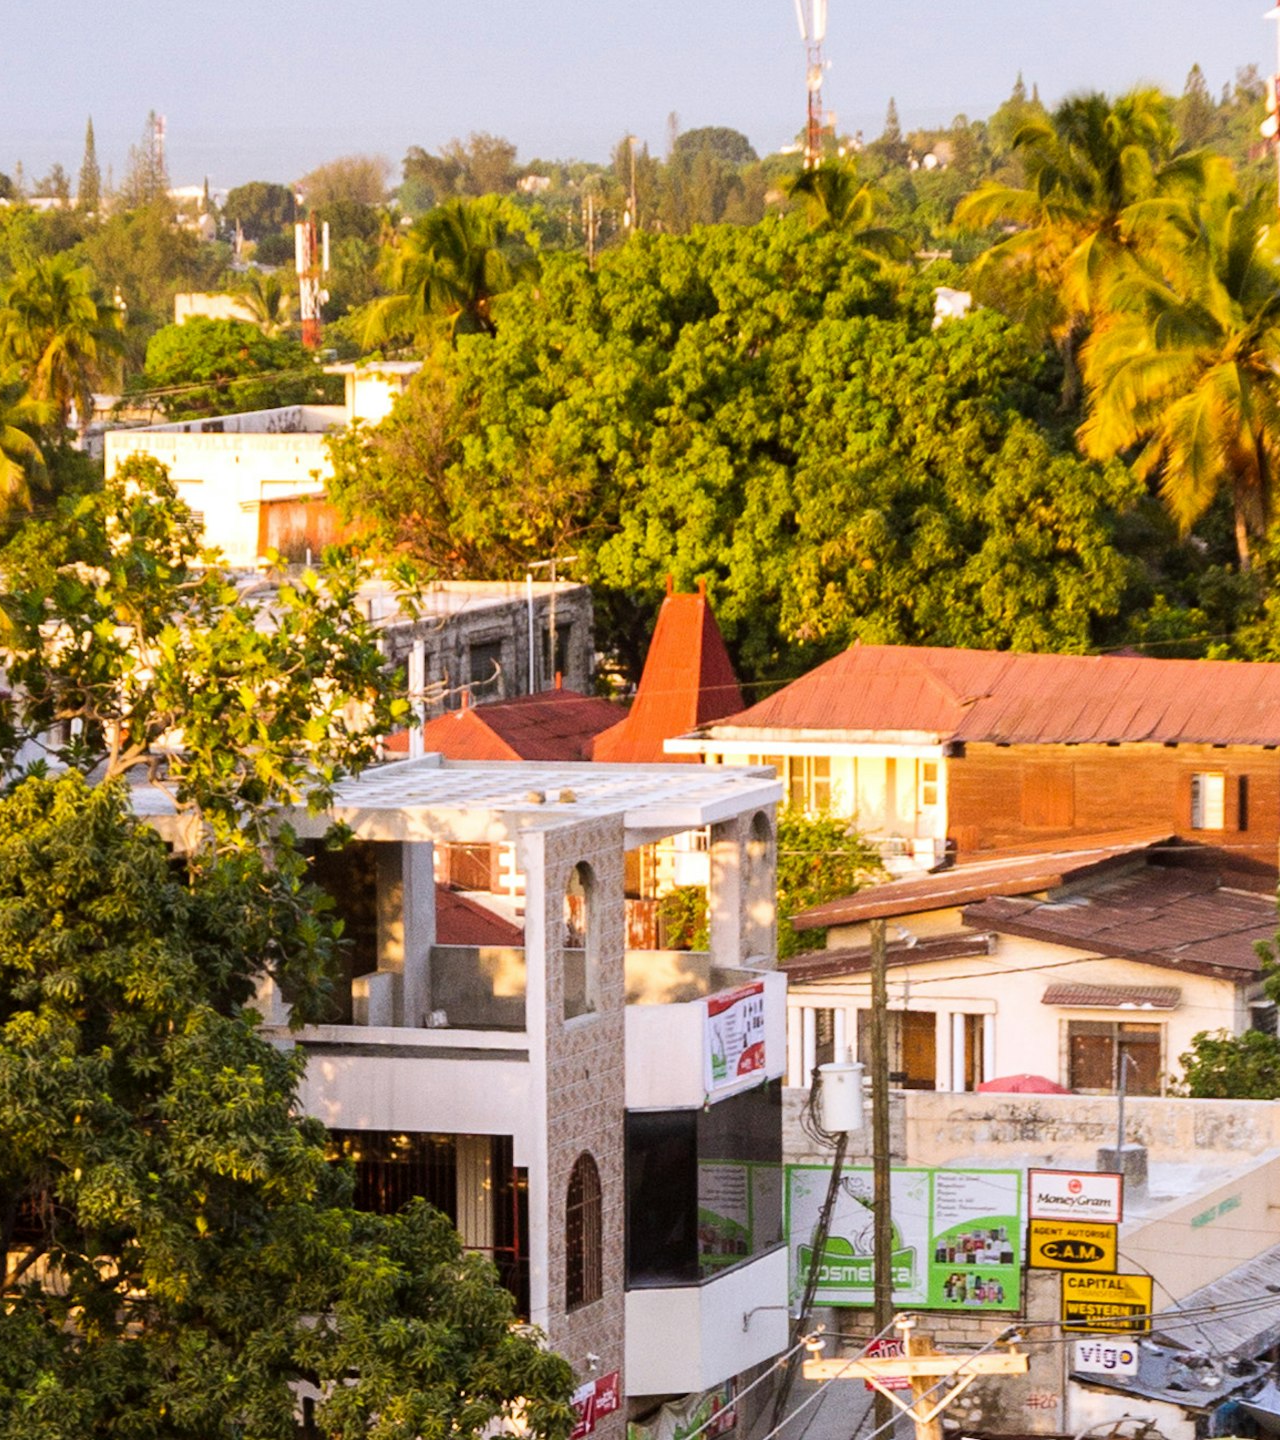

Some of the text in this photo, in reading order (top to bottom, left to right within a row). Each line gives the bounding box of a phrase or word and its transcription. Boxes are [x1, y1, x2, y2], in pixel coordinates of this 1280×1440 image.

[1037, 1193, 1111, 1207] MoneyGram
[1034, 1227, 1063, 1236] AGENT
[1042, 1242, 1101, 1260] C.A.M.
[1067, 1277, 1125, 1290] CAPITAL
[1066, 1303, 1130, 1316] WESTERN
[1080, 1343, 1133, 1369] vigo
